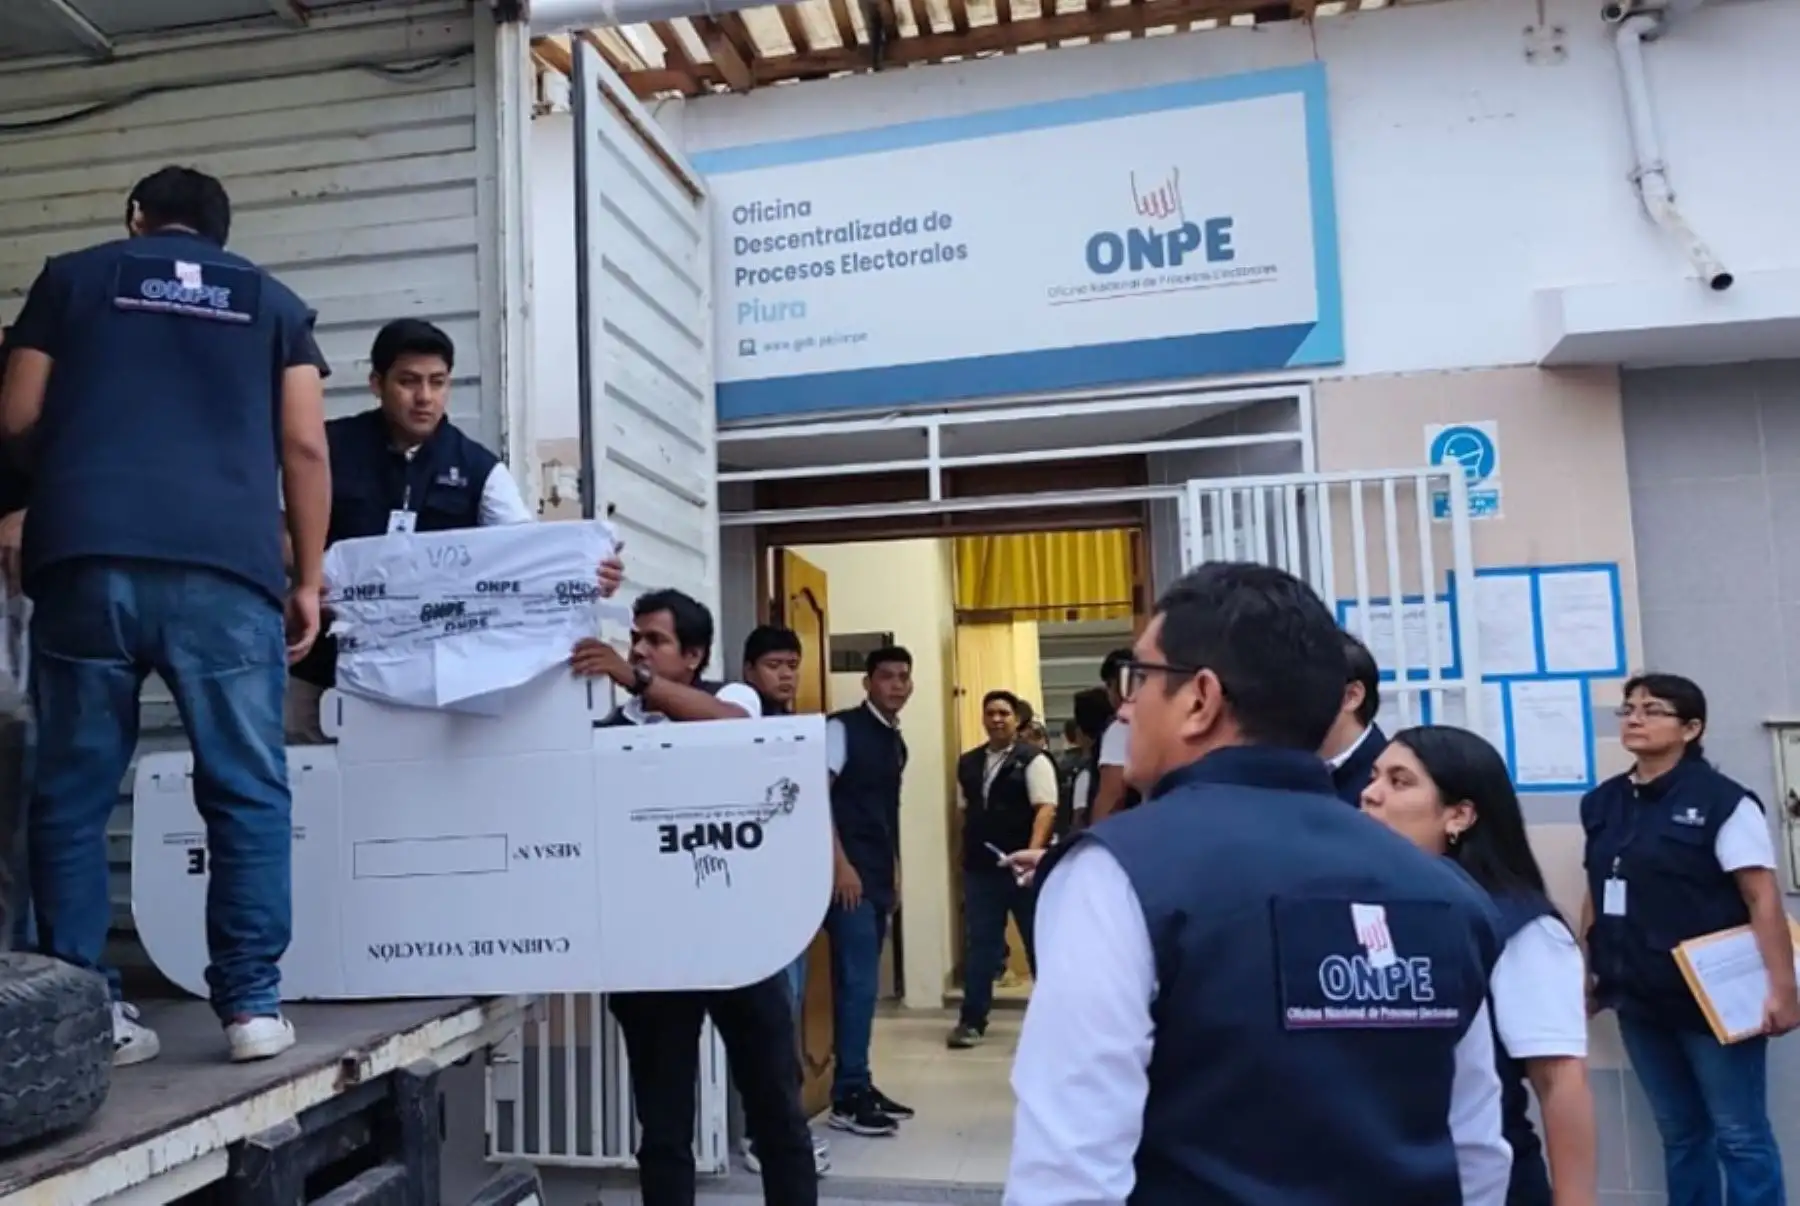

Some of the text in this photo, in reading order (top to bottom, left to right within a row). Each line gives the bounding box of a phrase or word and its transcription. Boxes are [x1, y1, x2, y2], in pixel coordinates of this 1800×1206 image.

[732, 199, 812, 225] Oficina
[733, 211, 953, 256] Descentralizada de
[1085, 216, 1235, 275] ONPE
[735, 242, 968, 287] Procesos Electorales
[141, 277, 232, 309] ONPE
[737, 298, 807, 325] Piura
[343, 583, 386, 600] ONPE
[475, 580, 521, 593] ONPE
[533, 842, 582, 860] MESA
[658, 821, 763, 854] ONPE
[368, 937, 570, 963] CABINA DE VOTACIÓN
[1319, 955, 1435, 1001] ONPE
